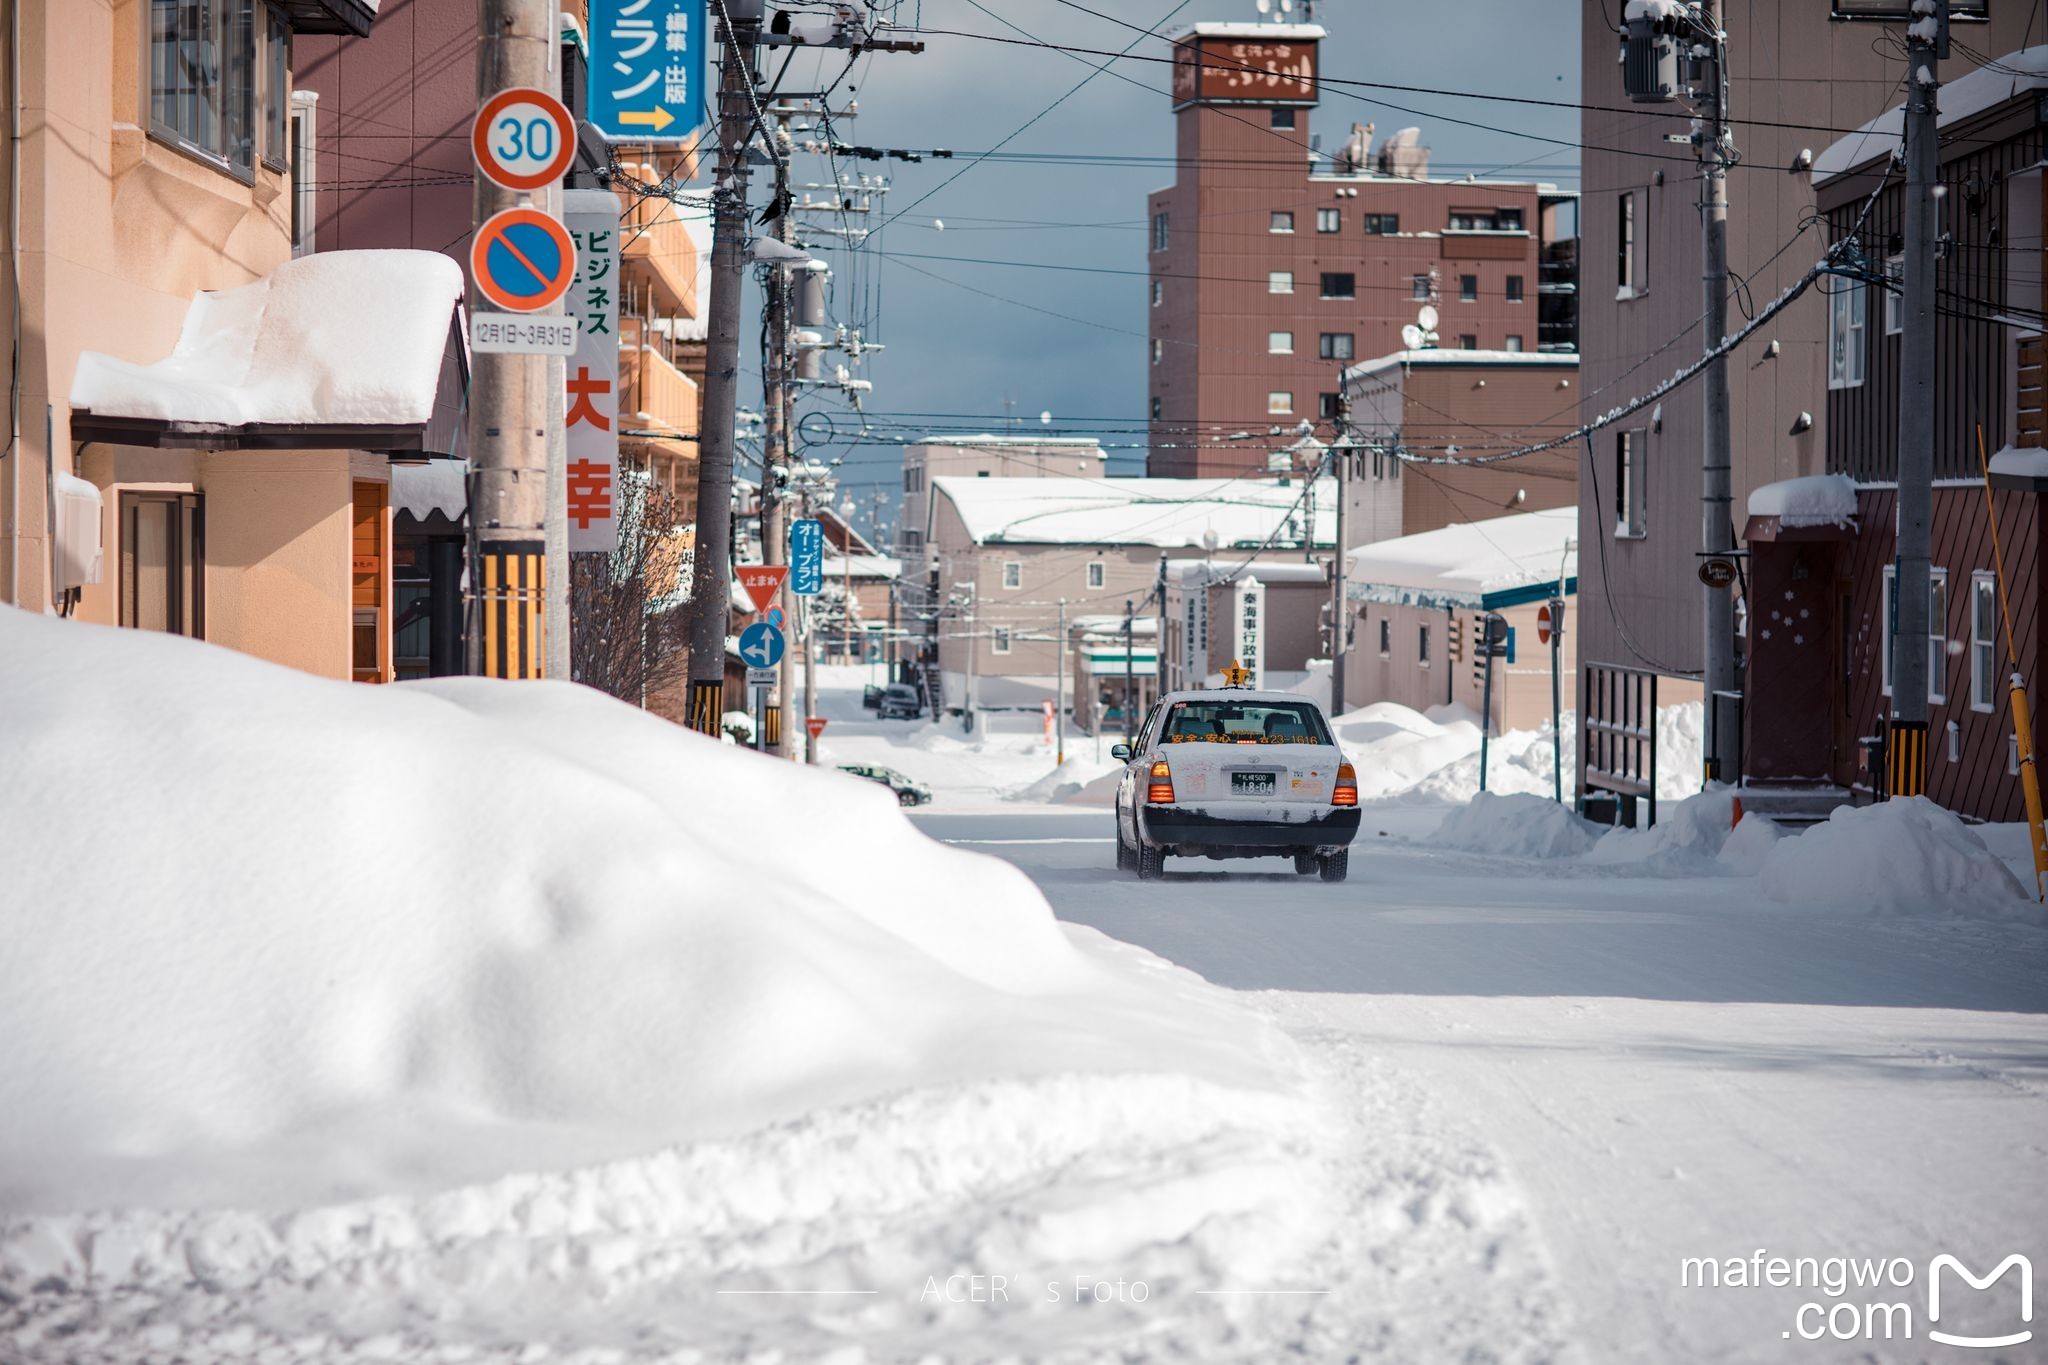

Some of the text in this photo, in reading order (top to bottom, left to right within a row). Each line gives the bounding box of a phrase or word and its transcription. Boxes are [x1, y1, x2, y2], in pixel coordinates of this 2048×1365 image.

[498, 117, 552, 161] 30
[587, 230, 611, 335] ビジネス
[566, 366, 611, 529] 大幸
[745, 574, 778, 587] 止まれ
[798, 523, 812, 591] オー・プラン
